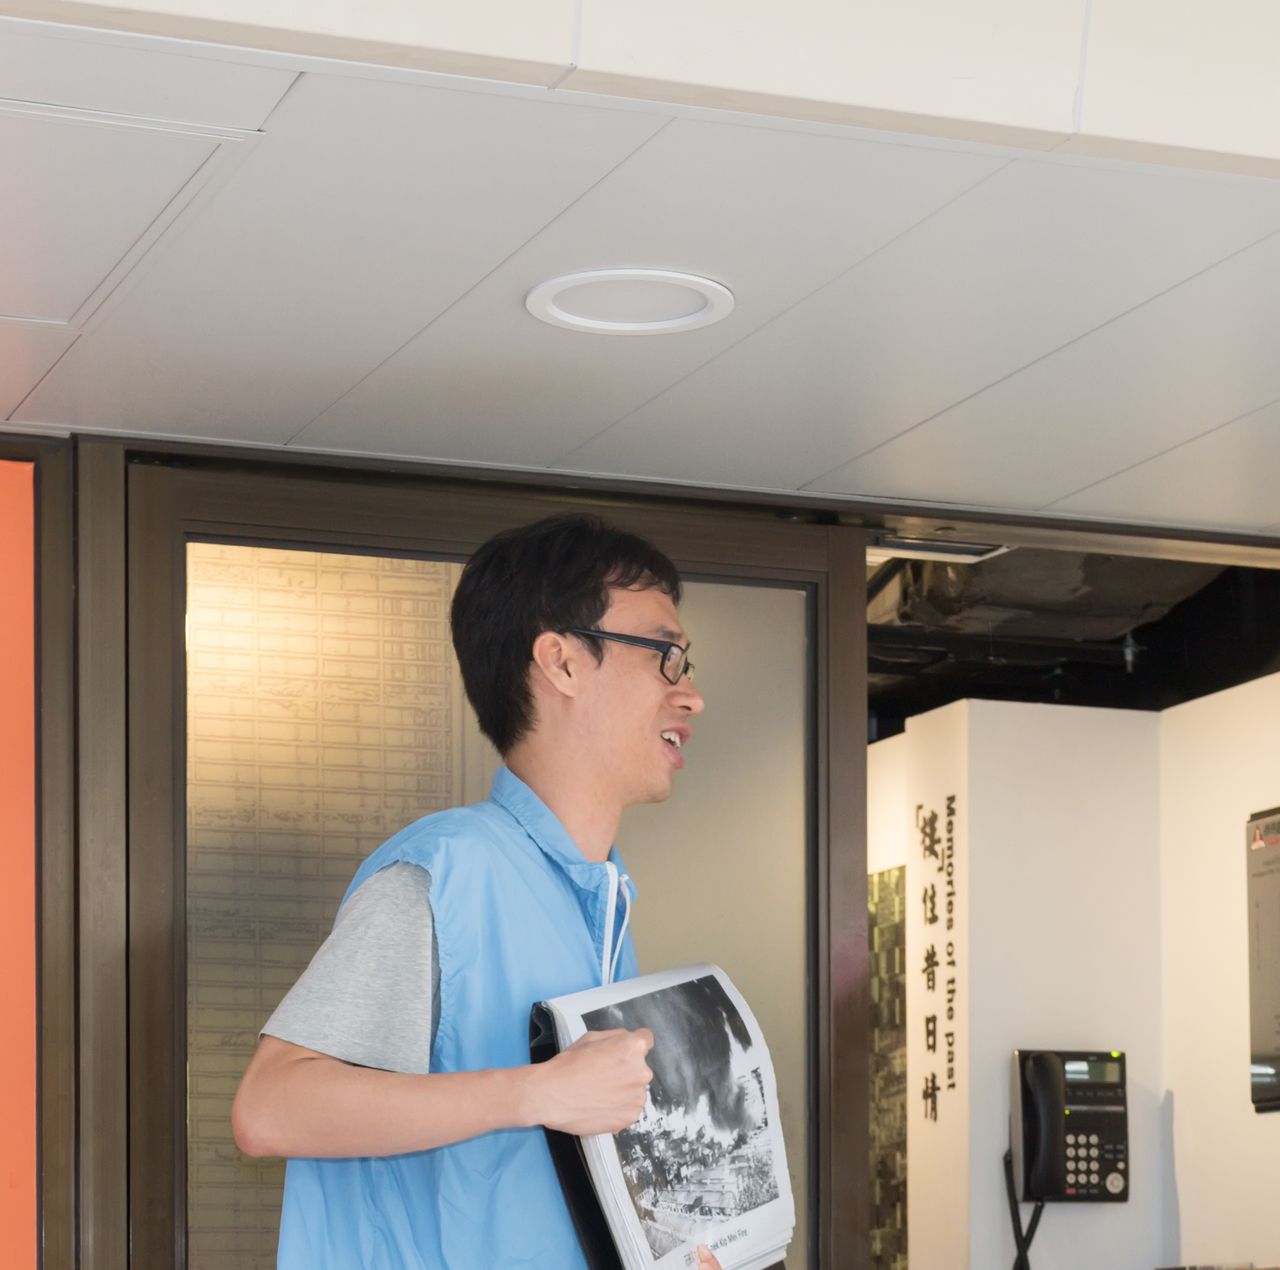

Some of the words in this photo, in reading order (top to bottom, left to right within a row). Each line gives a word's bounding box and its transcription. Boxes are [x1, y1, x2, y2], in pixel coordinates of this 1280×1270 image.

[945, 794, 957, 931] Memories
[945, 941, 957, 967] of
[945, 977, 957, 1021] the
[944, 1031, 957, 1091] past
